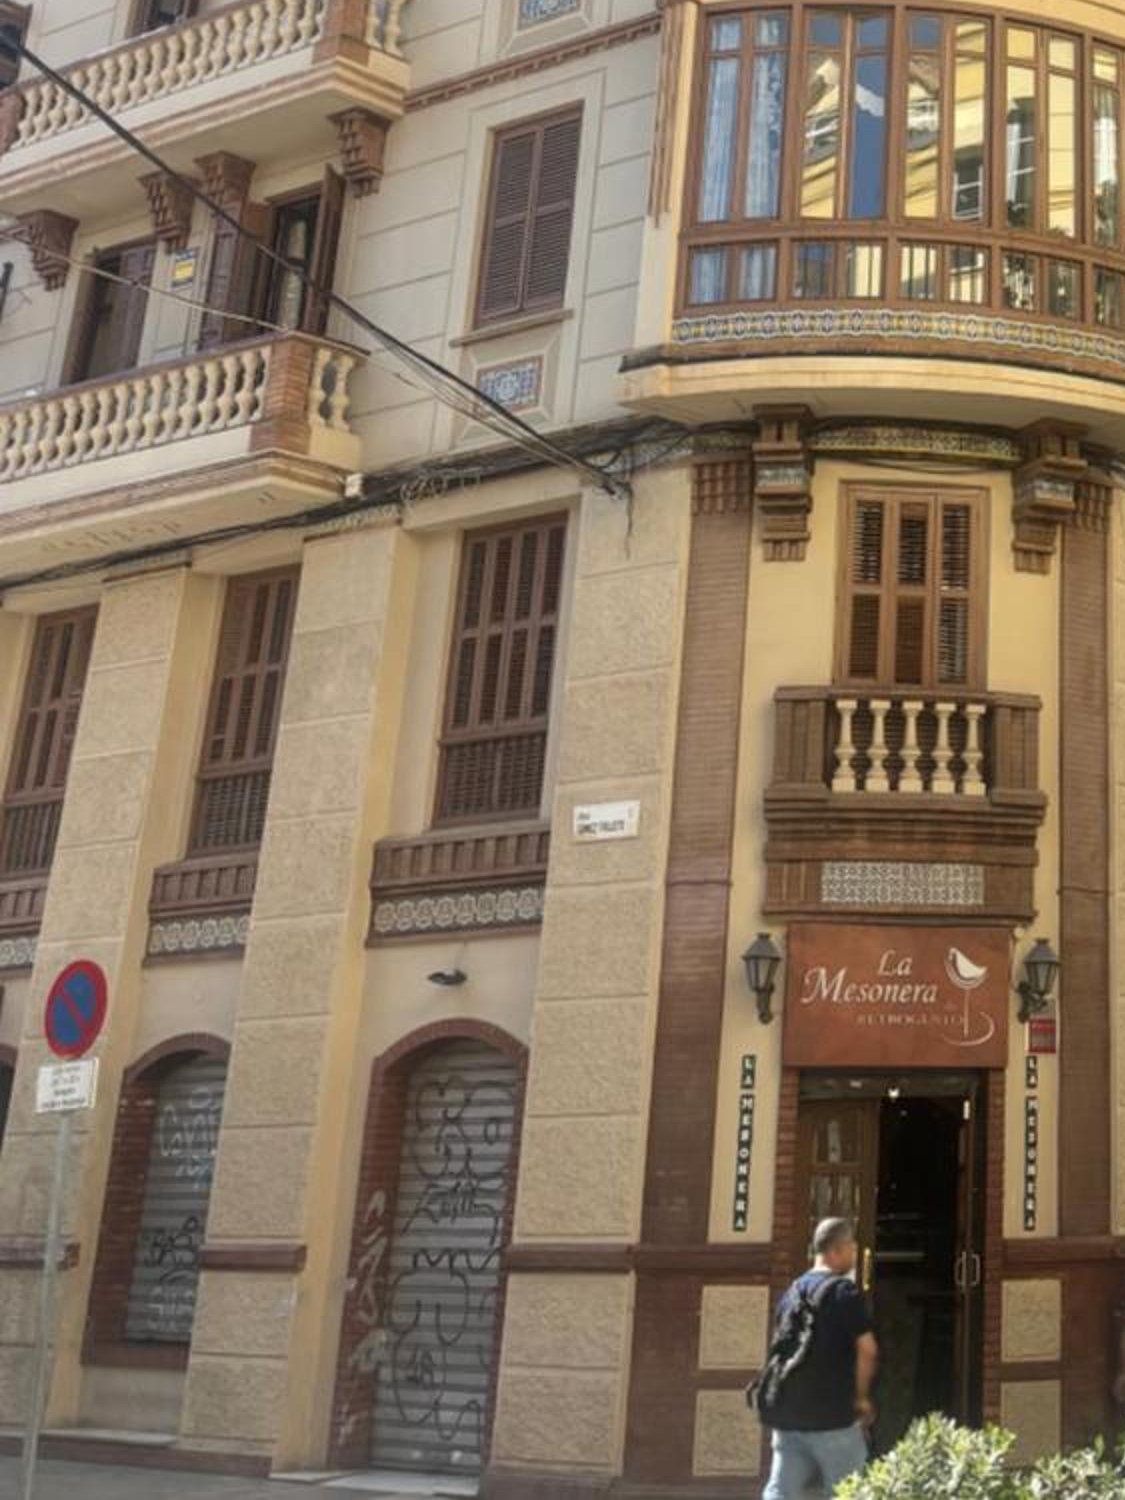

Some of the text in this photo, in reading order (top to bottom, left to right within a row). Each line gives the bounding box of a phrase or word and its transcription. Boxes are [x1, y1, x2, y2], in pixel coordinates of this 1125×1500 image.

[877, 948, 912, 977] La
[800, 966, 937, 1004] Mesonera
[742, 1056, 755, 1088] LA
